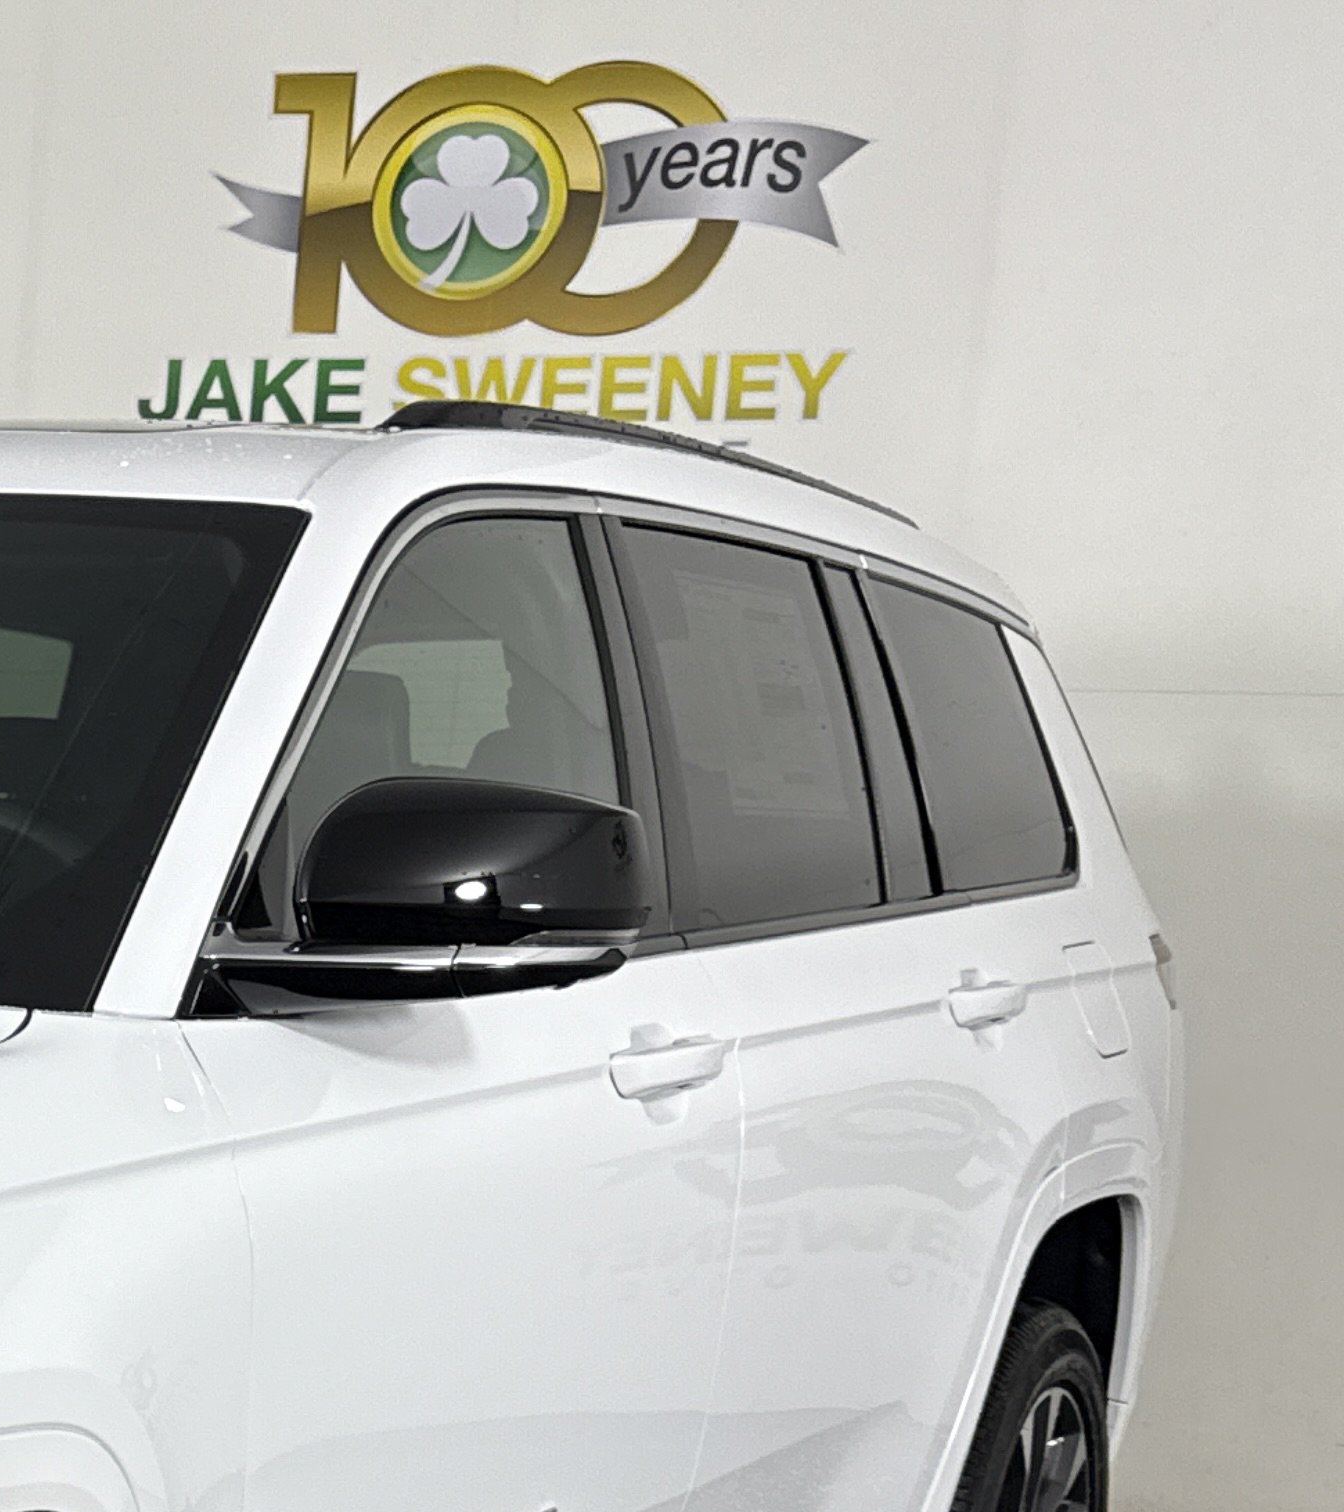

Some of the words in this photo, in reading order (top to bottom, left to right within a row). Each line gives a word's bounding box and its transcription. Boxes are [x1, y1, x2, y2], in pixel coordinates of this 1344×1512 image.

[272, 60, 739, 337] 100
[616, 135, 808, 213] years
[138, 357, 366, 423] JAKE
[393, 351, 848, 421] SWEENEY
